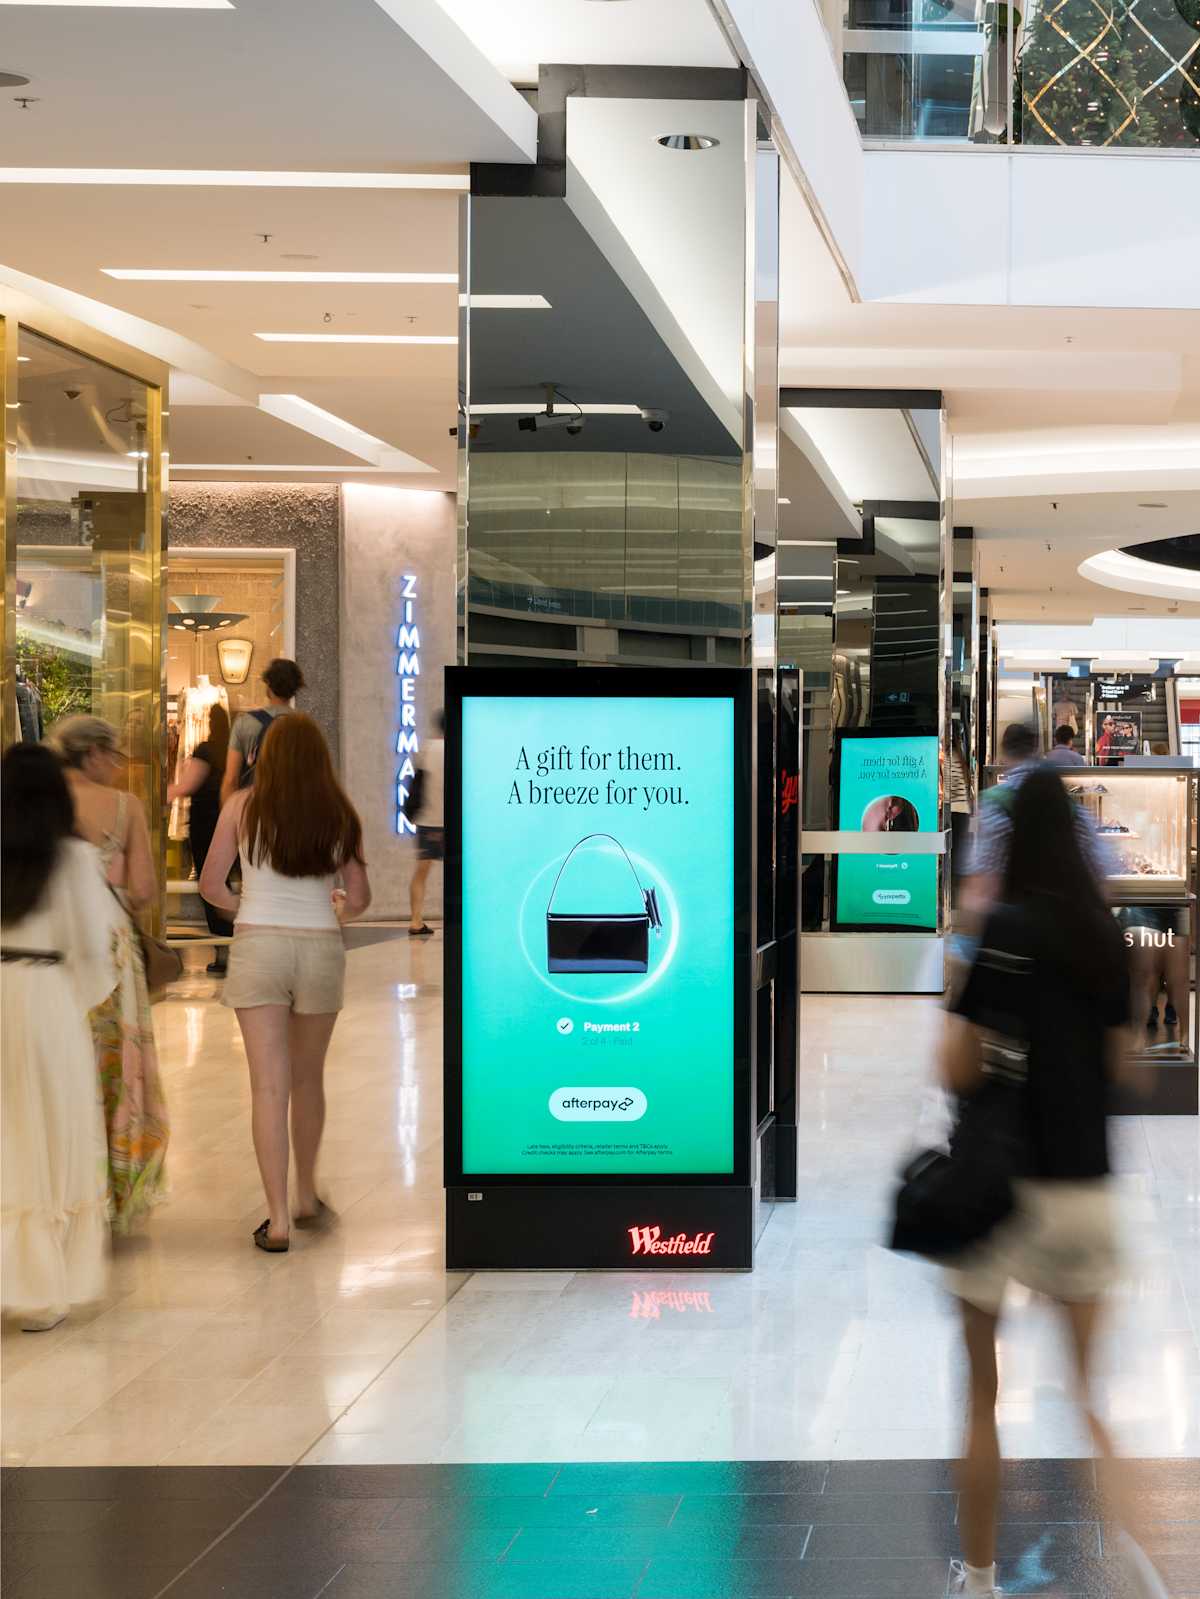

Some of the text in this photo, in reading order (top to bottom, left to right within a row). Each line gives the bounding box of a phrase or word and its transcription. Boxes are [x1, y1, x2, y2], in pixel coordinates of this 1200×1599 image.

[516, 745, 681, 777] A gift for them.
[507, 779, 690, 811] A breeze for you.
[1140, 926, 1175, 948] hut
[583, 1021, 641, 1034] Payment 2
[562, 1097, 618, 1111] afterpay
[627, 1226, 715, 1255] Westfield
